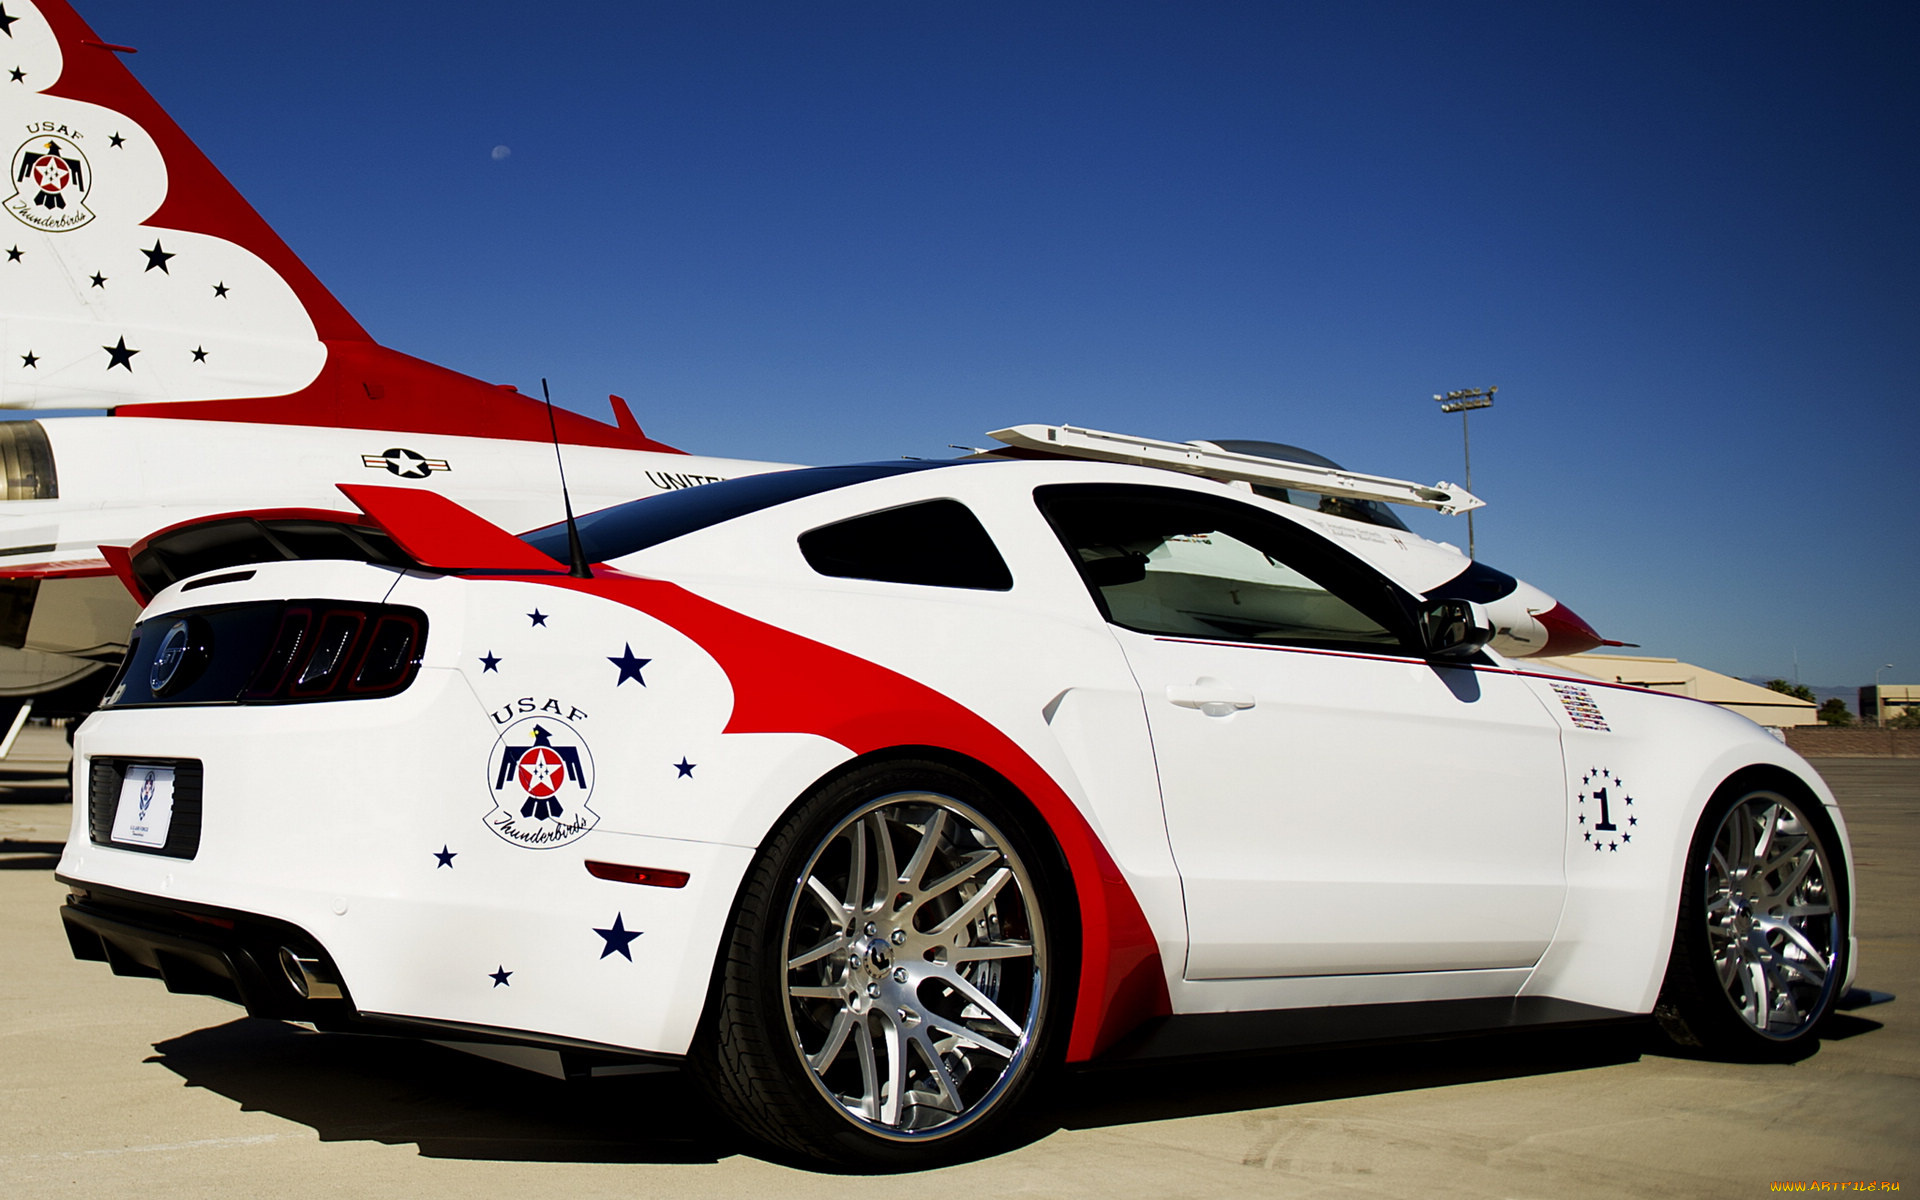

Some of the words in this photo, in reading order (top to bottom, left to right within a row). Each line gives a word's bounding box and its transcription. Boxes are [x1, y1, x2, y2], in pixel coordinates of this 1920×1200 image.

[26, 121, 84, 140] USAF
[13, 200, 86, 228] Thunderbirds
[644, 471, 727, 490] UNIT
[491, 697, 588, 725] USAF
[1593, 787, 1617, 831] 1
[494, 811, 587, 844] Thunderbirds
